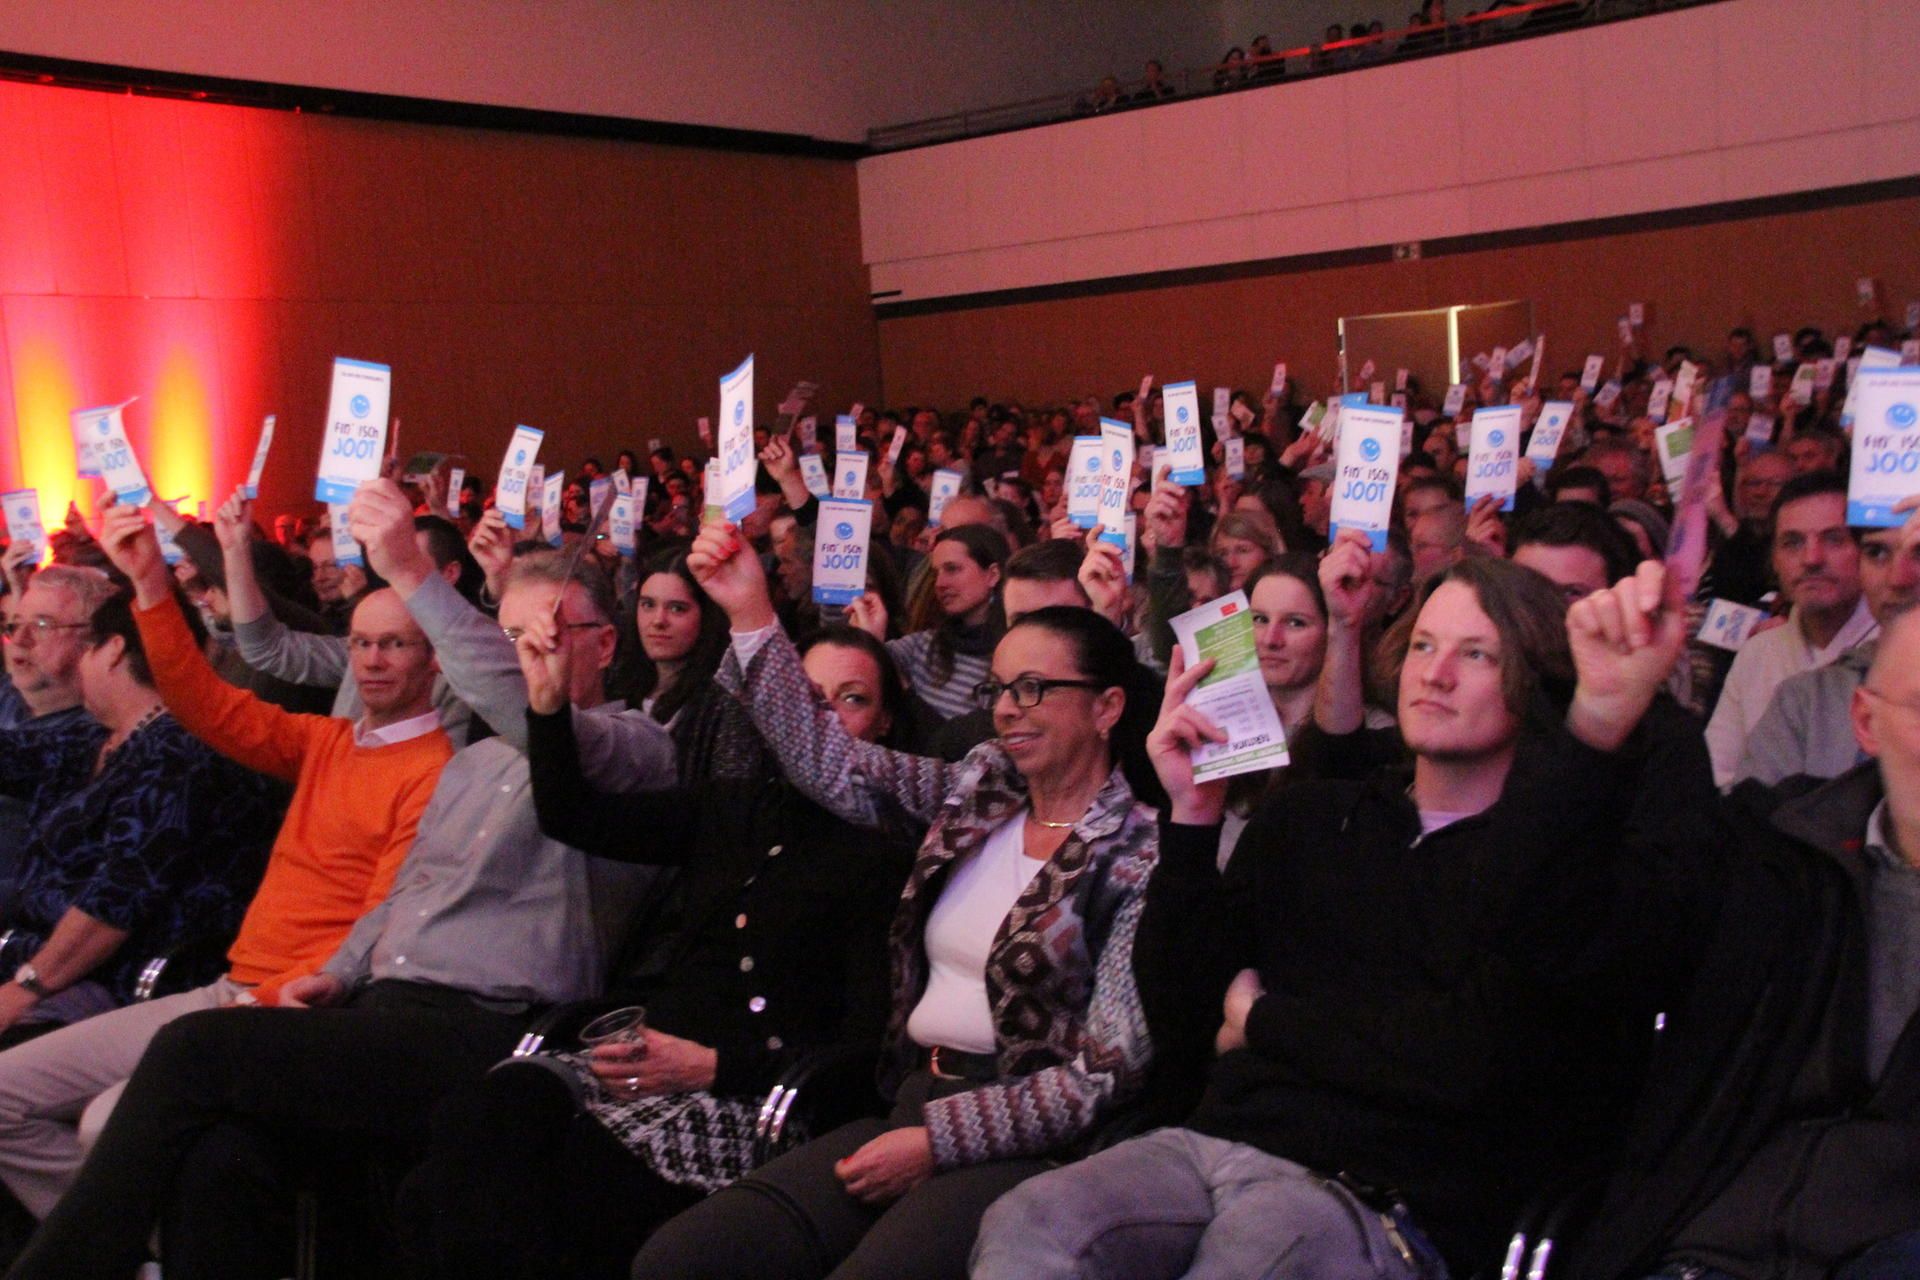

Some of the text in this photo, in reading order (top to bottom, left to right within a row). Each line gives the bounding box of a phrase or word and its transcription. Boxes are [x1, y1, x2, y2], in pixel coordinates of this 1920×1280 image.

[332, 438, 376, 459] JOOT
[1172, 436, 1197, 453] JOOT
[1475, 459, 1512, 478] JOOT
[1866, 451, 1920, 474] JOO
[1075, 483, 1100, 498] JOO
[1342, 480, 1386, 502] JOOT
[822, 554, 861, 570] JOOT
